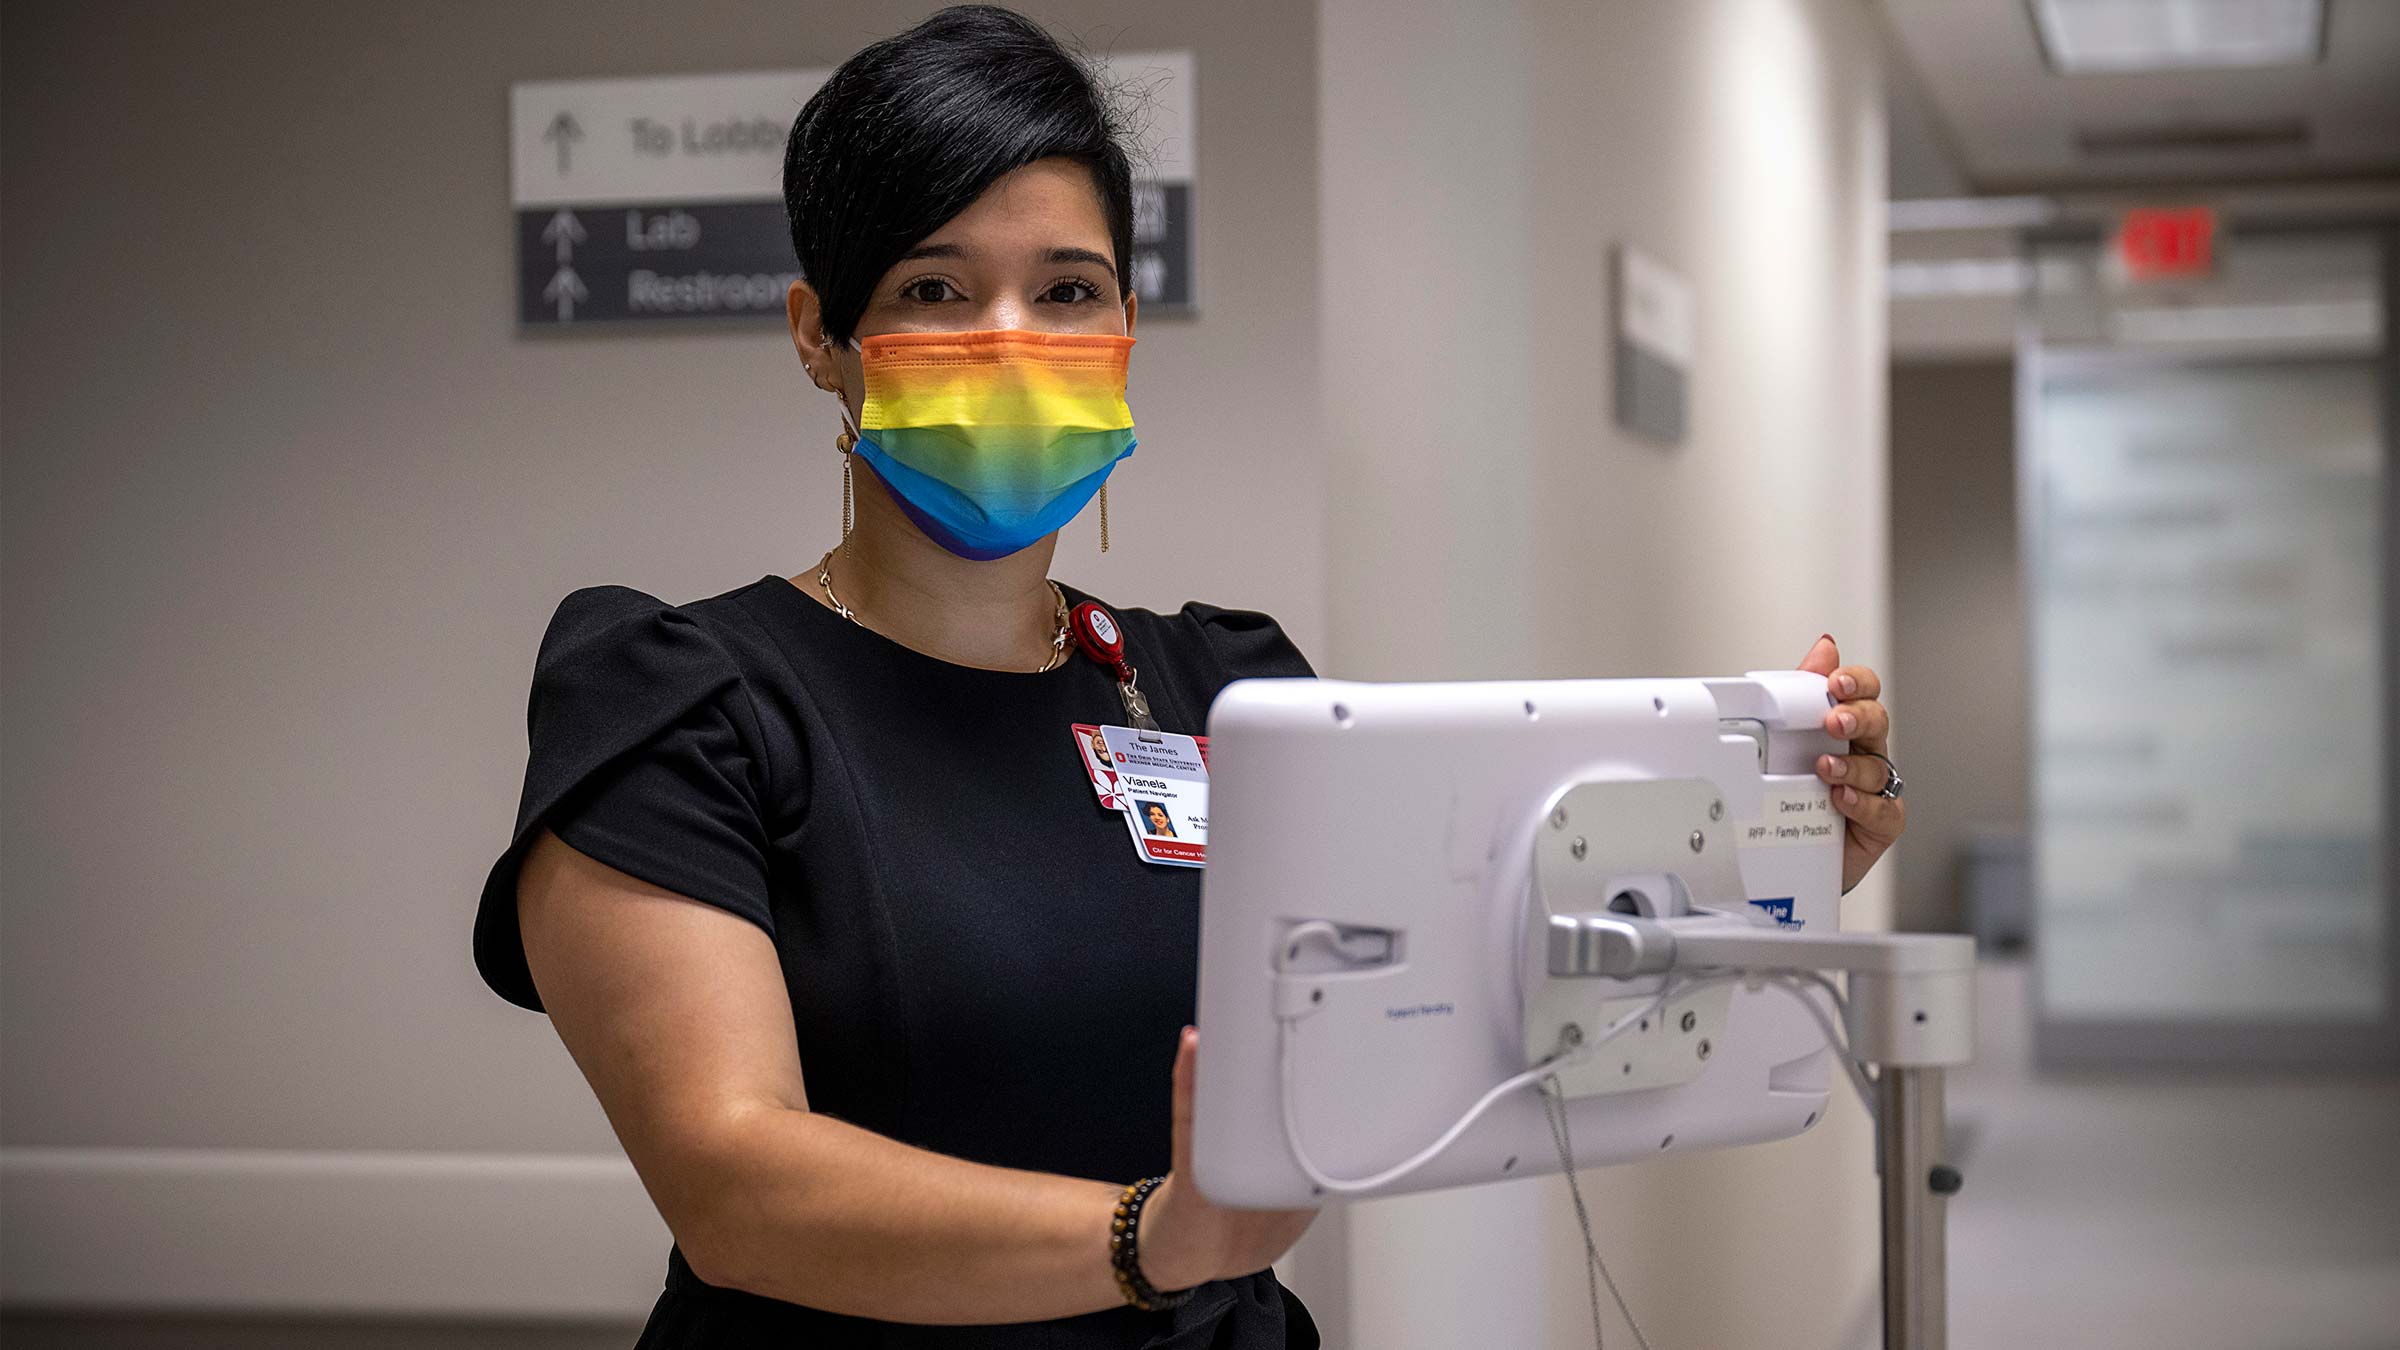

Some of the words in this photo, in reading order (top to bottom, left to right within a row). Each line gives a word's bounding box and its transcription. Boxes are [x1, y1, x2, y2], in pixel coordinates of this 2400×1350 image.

[626, 209, 701, 250] Lab
[1129, 742, 1148, 752] The
[1150, 744, 1179, 756] James
[1152, 762, 1176, 770] MEDICAL
[1122, 775, 1168, 790] Vianela
[1127, 787, 1149, 795] Patient
[1149, 790, 1178, 798] Navigator
[1780, 800, 1805, 813] Device
[1187, 815, 1200, 823] Ask
[1776, 825, 1800, 839] Family
[1173, 849, 1196, 857] Cancer
